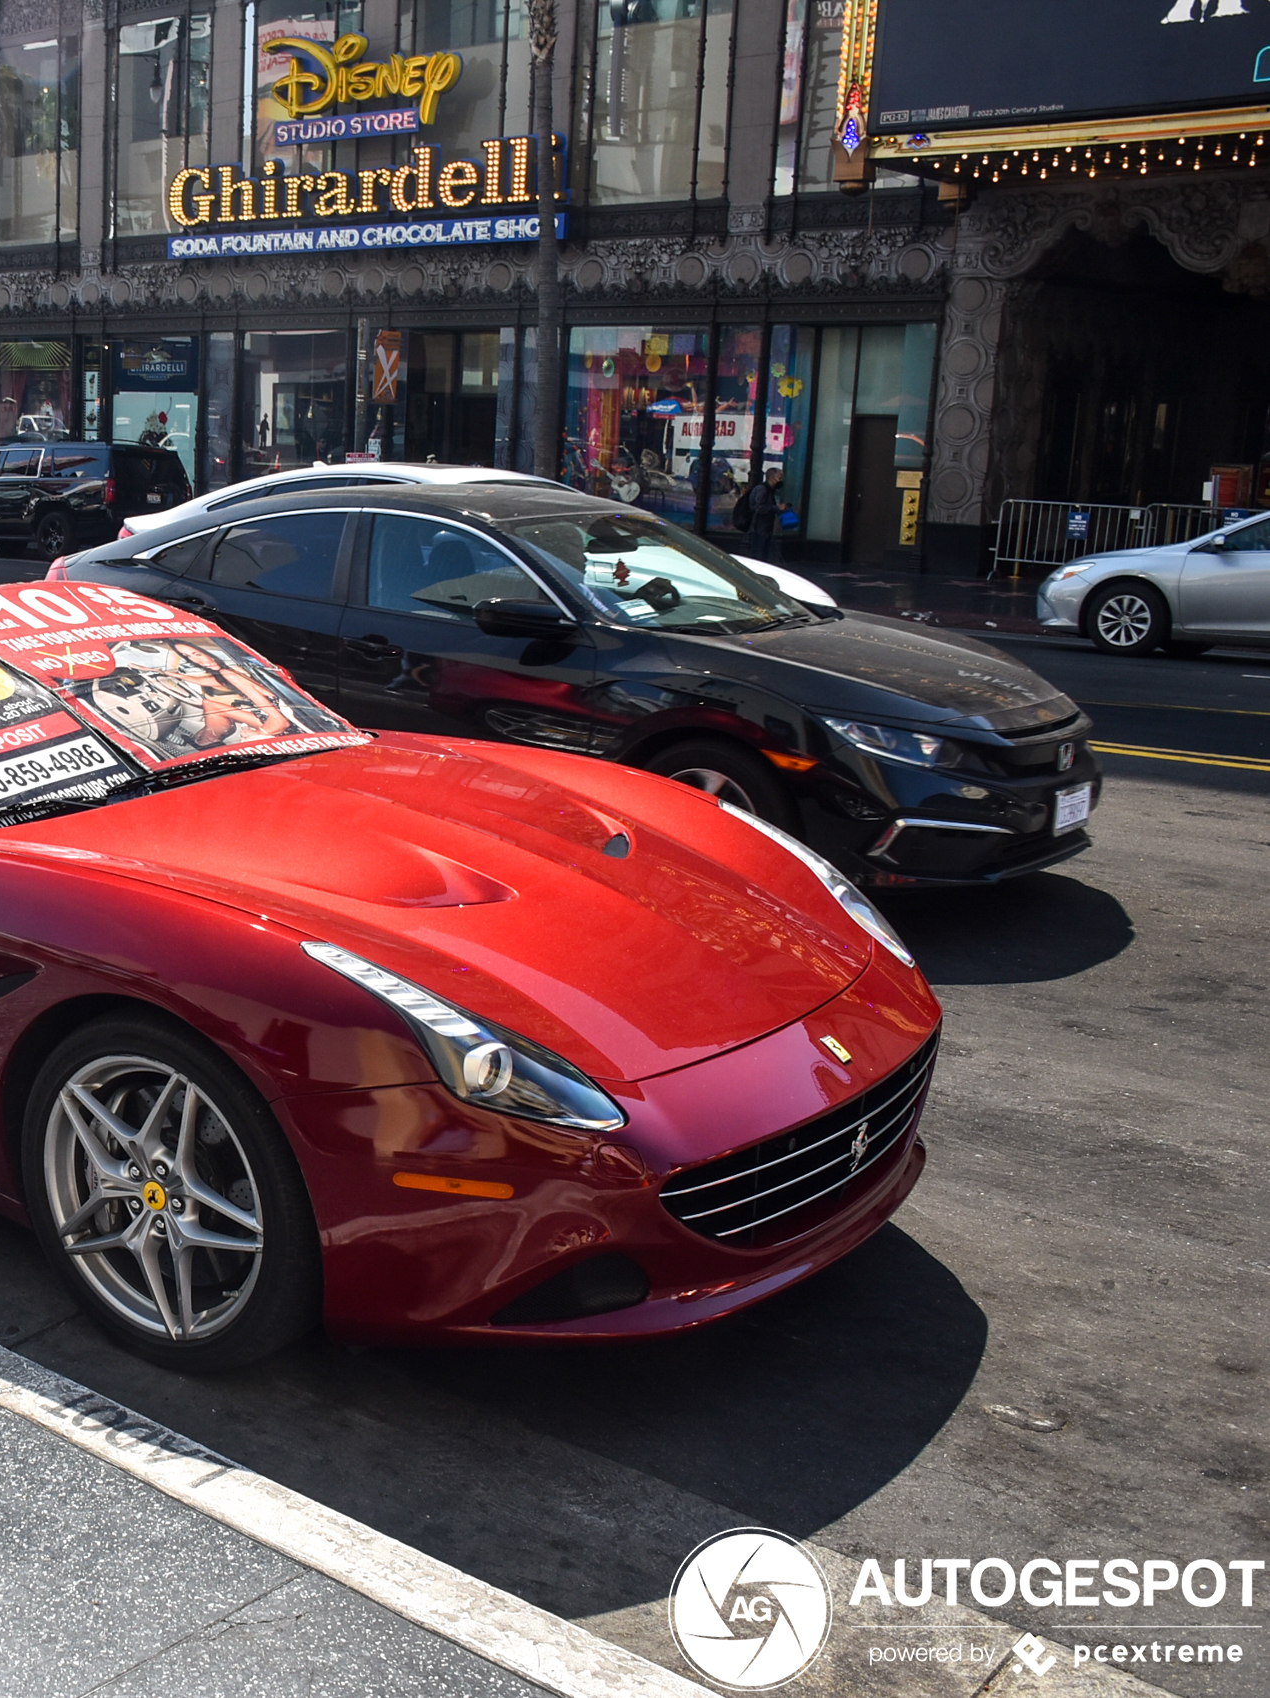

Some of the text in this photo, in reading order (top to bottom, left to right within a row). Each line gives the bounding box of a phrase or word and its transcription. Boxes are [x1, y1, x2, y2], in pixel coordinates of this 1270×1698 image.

[276, 111, 417, 143] STUDIO STORE
[883, 113, 907, 121] PG-13
[994, 108, 1010, 117] 20th
[1011, 106, 1038, 117] Century
[1038, 103, 1064, 112] Studios
[171, 217, 559, 258] SODA FOUNTAIN AND CHOCOLATE SHO
[82, 586, 177, 621] $5
[106, 604, 130, 616] Kid
[0, 621, 216, 652] TAKE YOUR PICTURE INSIDE THE CAR
[31, 650, 111, 671] NO VIDEO
